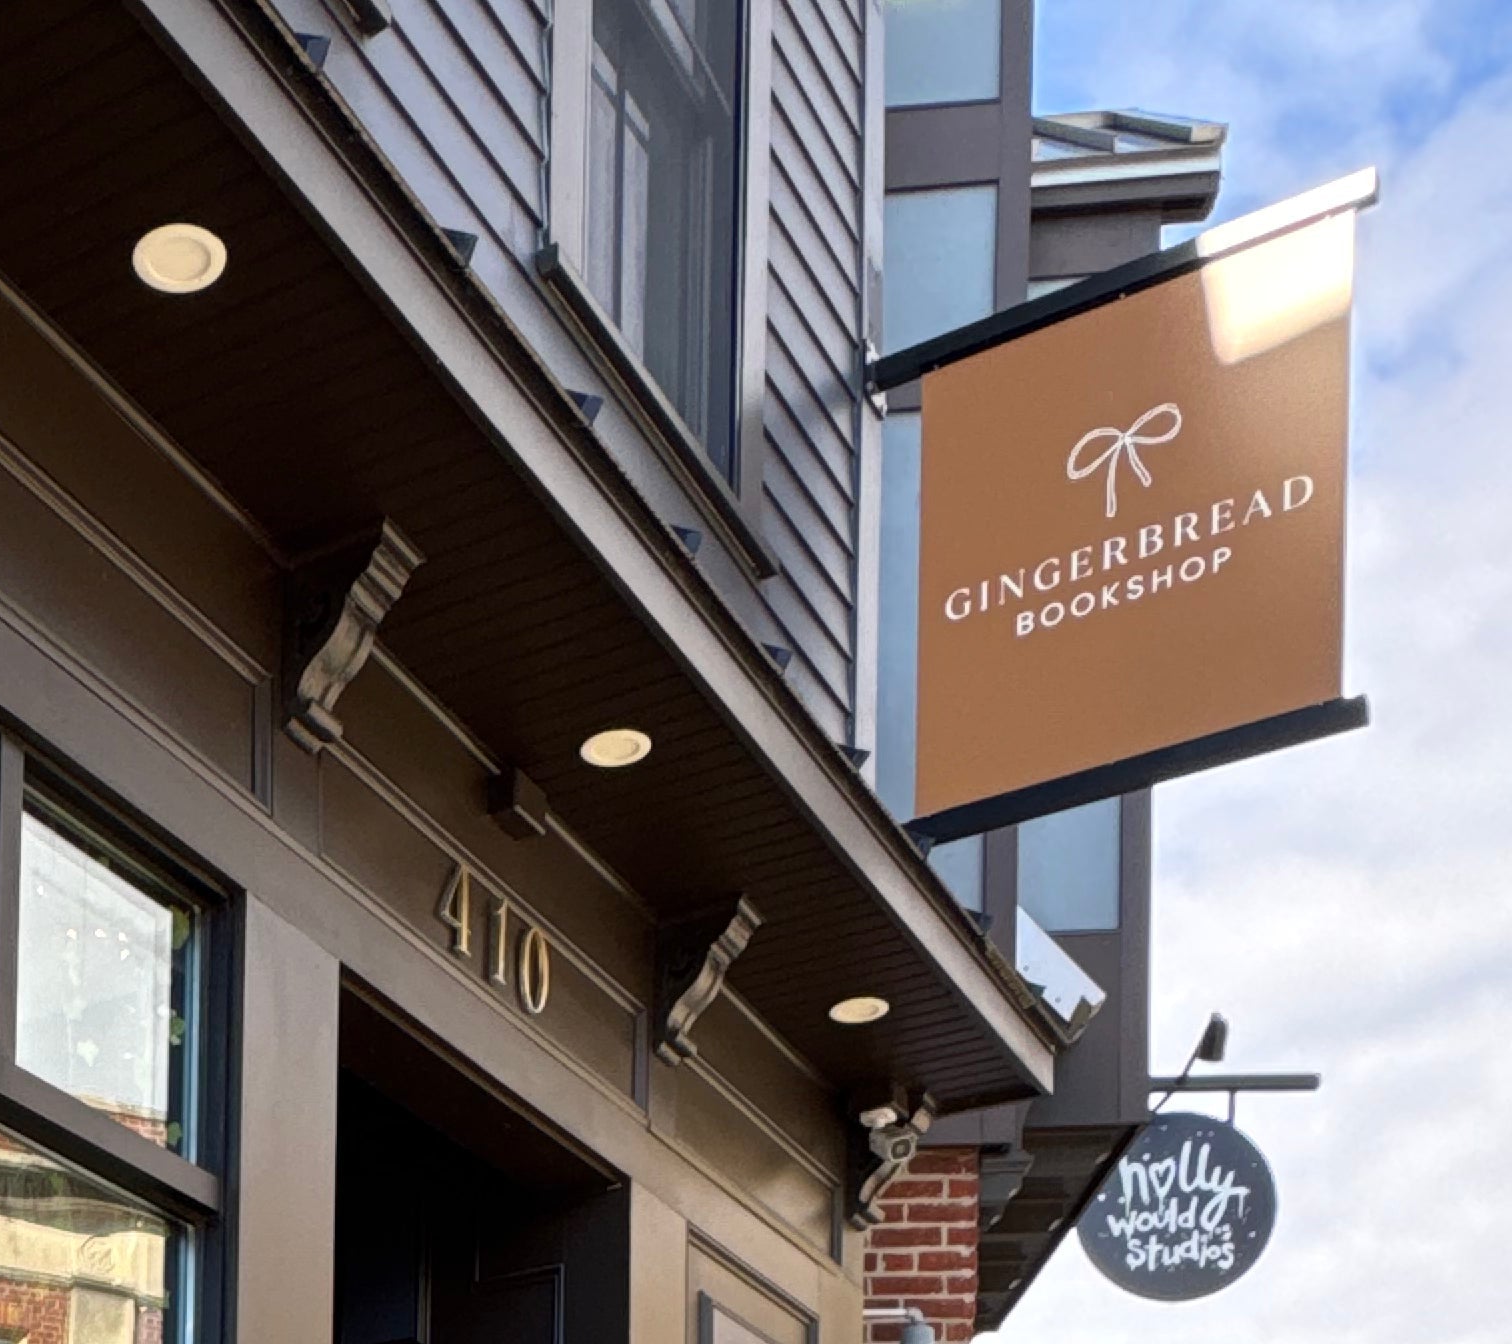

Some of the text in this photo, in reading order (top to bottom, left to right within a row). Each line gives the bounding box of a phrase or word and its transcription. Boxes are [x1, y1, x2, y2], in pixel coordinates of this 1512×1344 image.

[943, 474, 1314, 621] GINGERBREAD
[1015, 546, 1233, 637] BOOKSHOP
[440, 863, 550, 1014] 410
